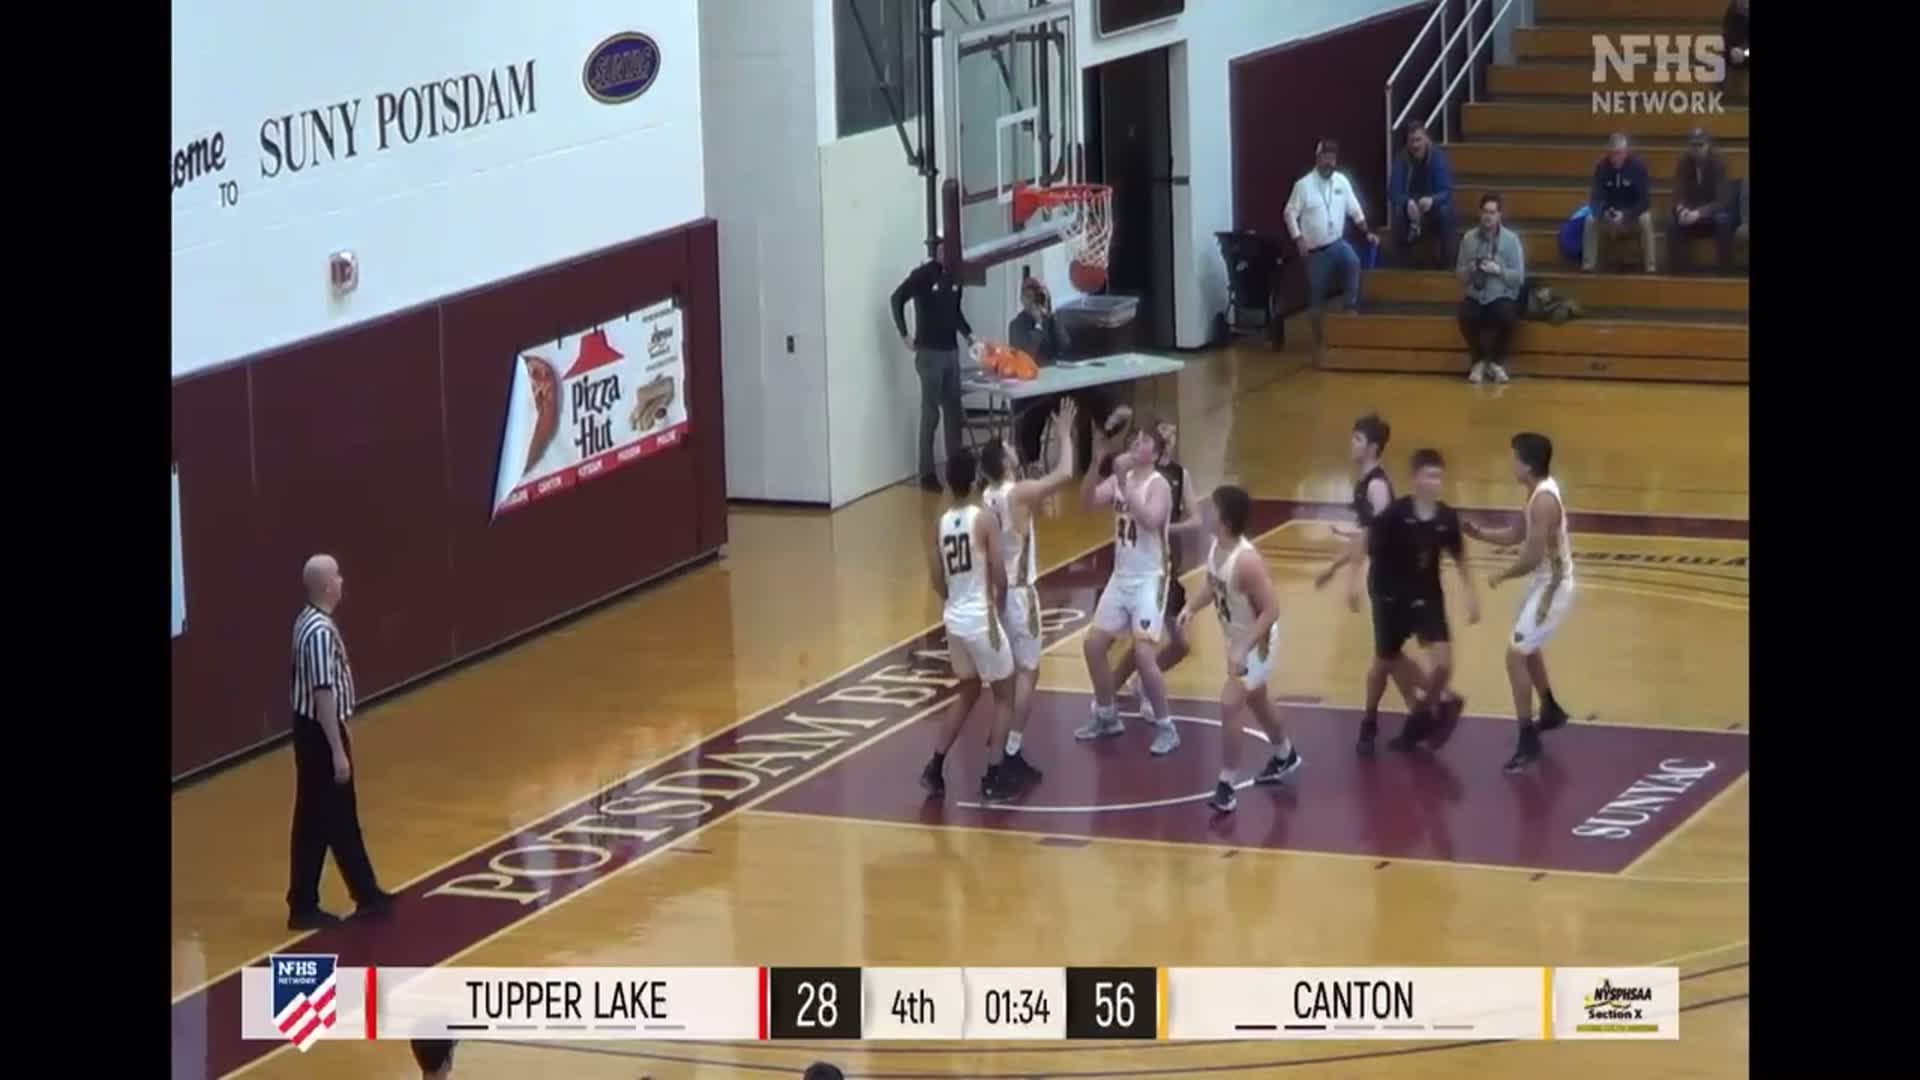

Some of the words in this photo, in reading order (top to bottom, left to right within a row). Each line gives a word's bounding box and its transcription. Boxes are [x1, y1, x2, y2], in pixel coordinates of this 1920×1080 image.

[260, 99, 361, 178] SUNY
[376, 60, 537, 151] POTSDAM
[172, 131, 226, 192] ome
[218, 180, 239, 208] TO
[572, 375, 621, 425] Pizza
[573, 415, 614, 458] Hut
[944, 533, 972, 576] 20
[422, 712, 886, 904] POTSDAM
[1571, 758, 1717, 839] SUNYAC
